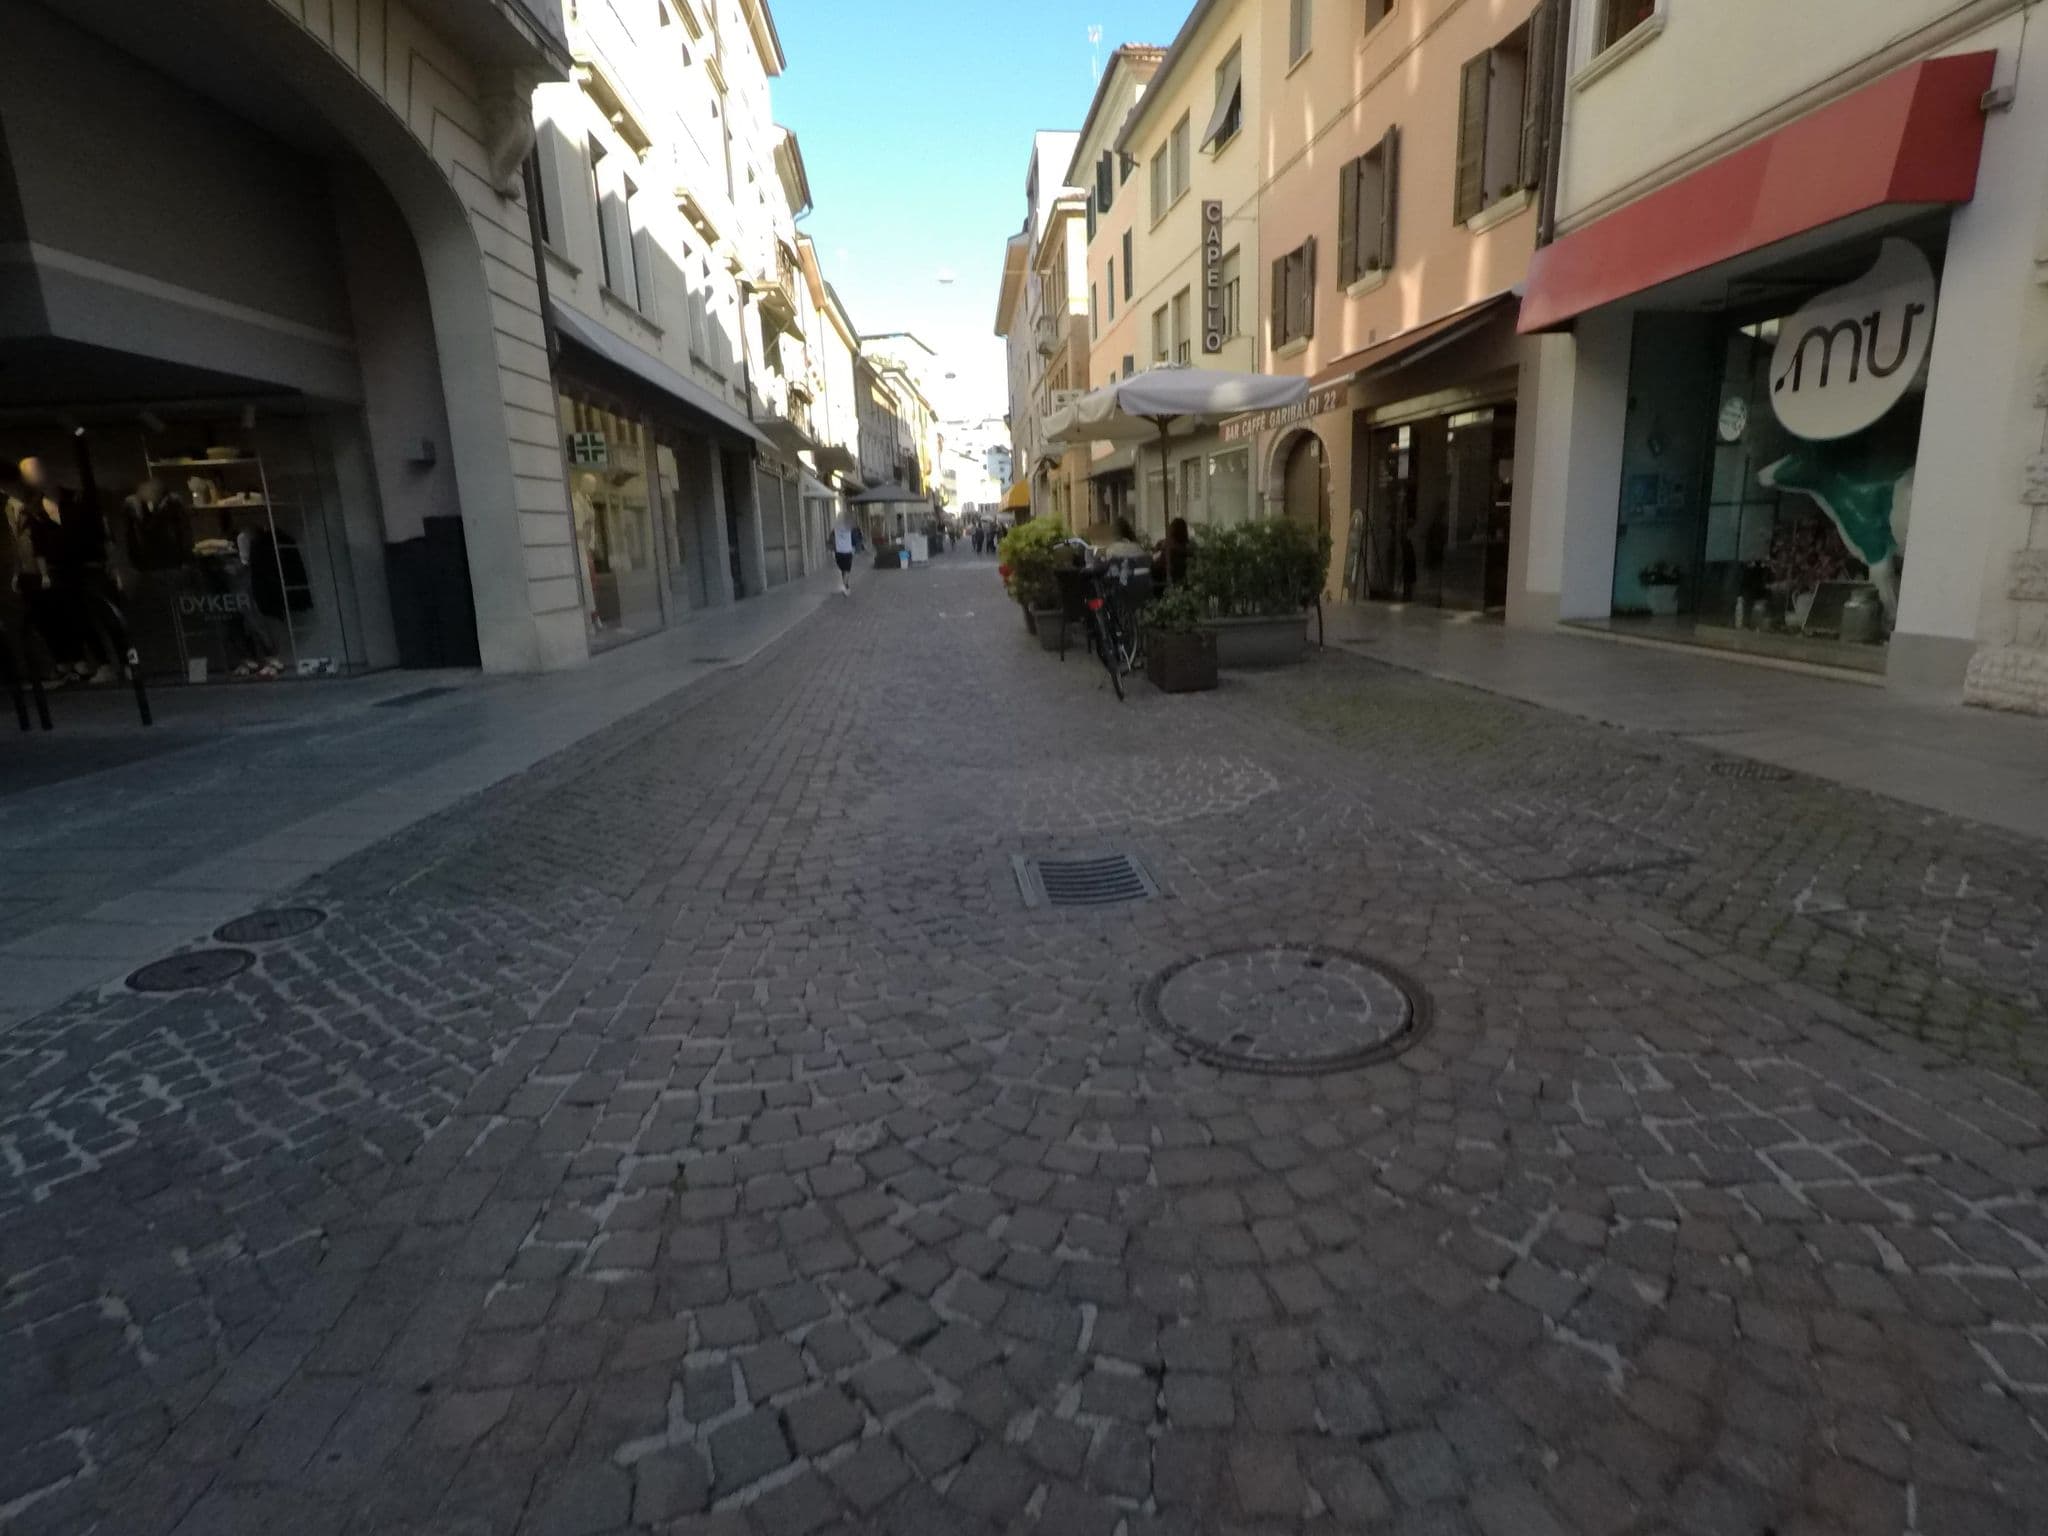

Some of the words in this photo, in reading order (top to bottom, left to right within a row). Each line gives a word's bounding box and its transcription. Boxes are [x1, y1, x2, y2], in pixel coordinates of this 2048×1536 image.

[1206, 203, 1220, 351] CAPELLO
[1225, 424, 1239, 442] BAR
[1269, 397, 1319, 427] GARIBALDI
[1324, 390, 1337, 409] 22
[179, 593, 251, 614] DYKER
